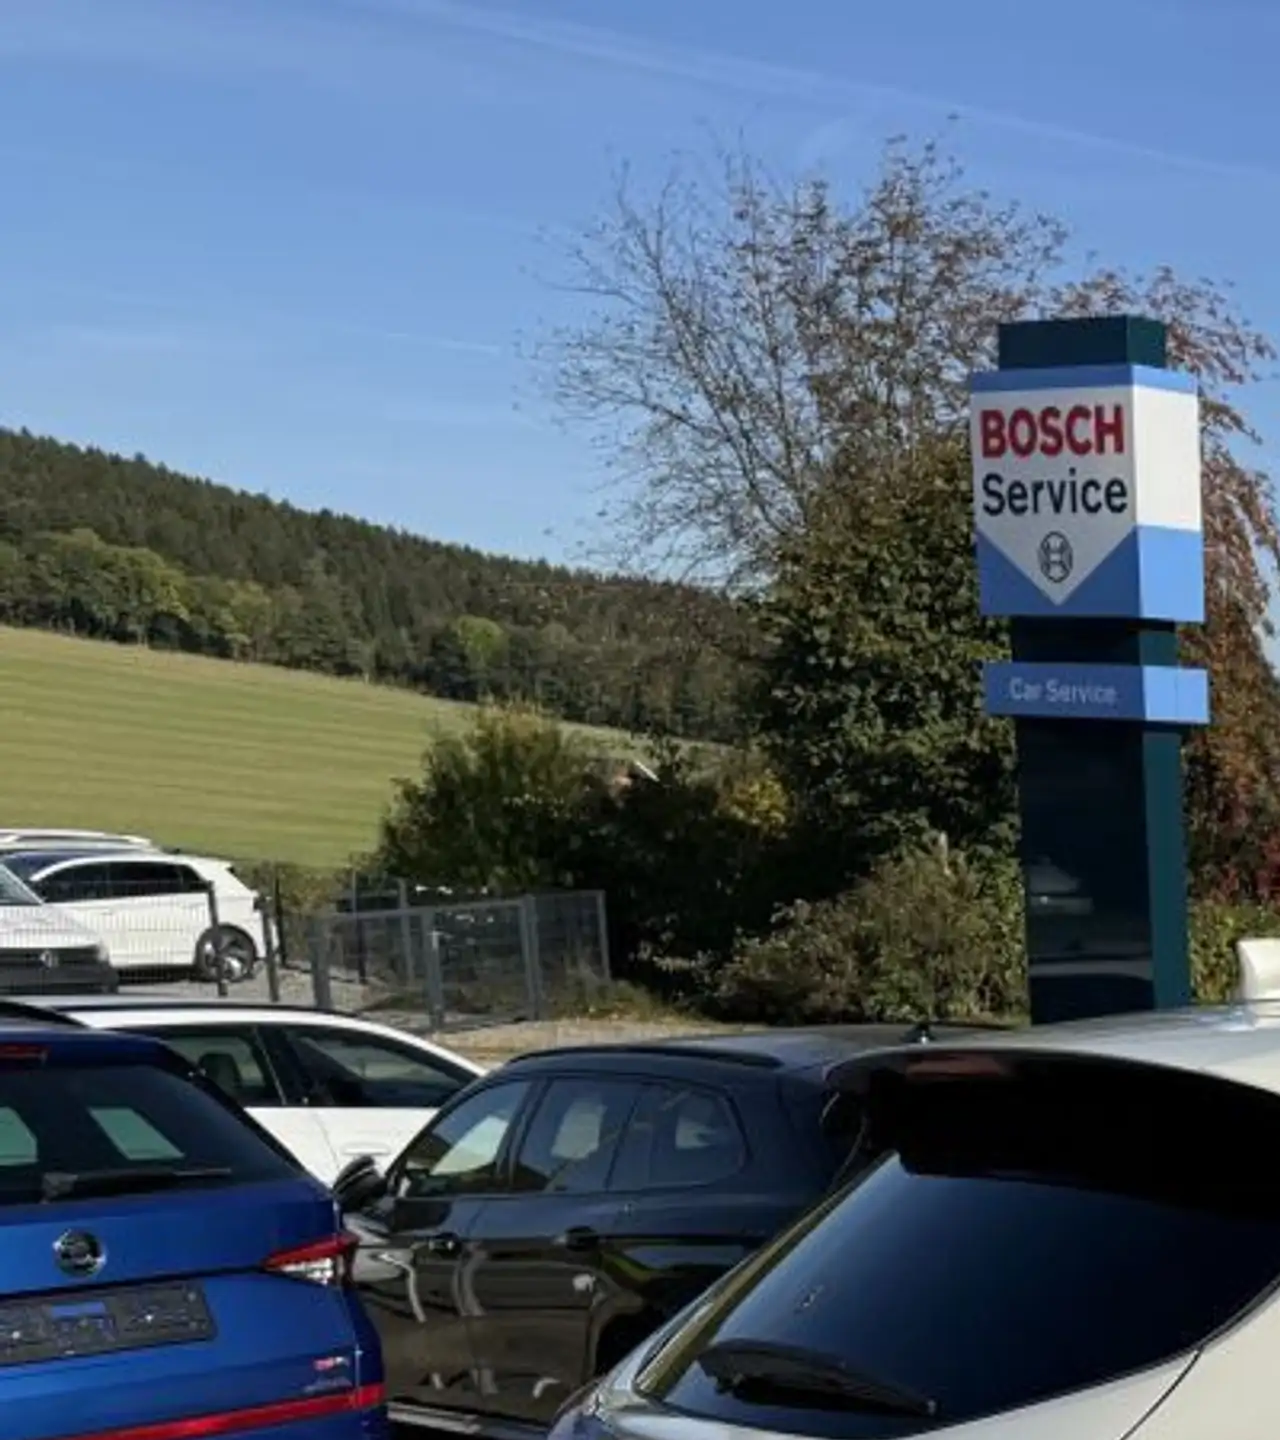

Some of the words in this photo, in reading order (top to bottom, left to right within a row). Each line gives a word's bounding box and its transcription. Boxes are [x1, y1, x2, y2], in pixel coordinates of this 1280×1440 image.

[980, 404, 1125, 458] BOSCH
[981, 467, 1128, 516] Service
[1009, 676, 1041, 700] Car
[1046, 677, 1117, 704] Service
